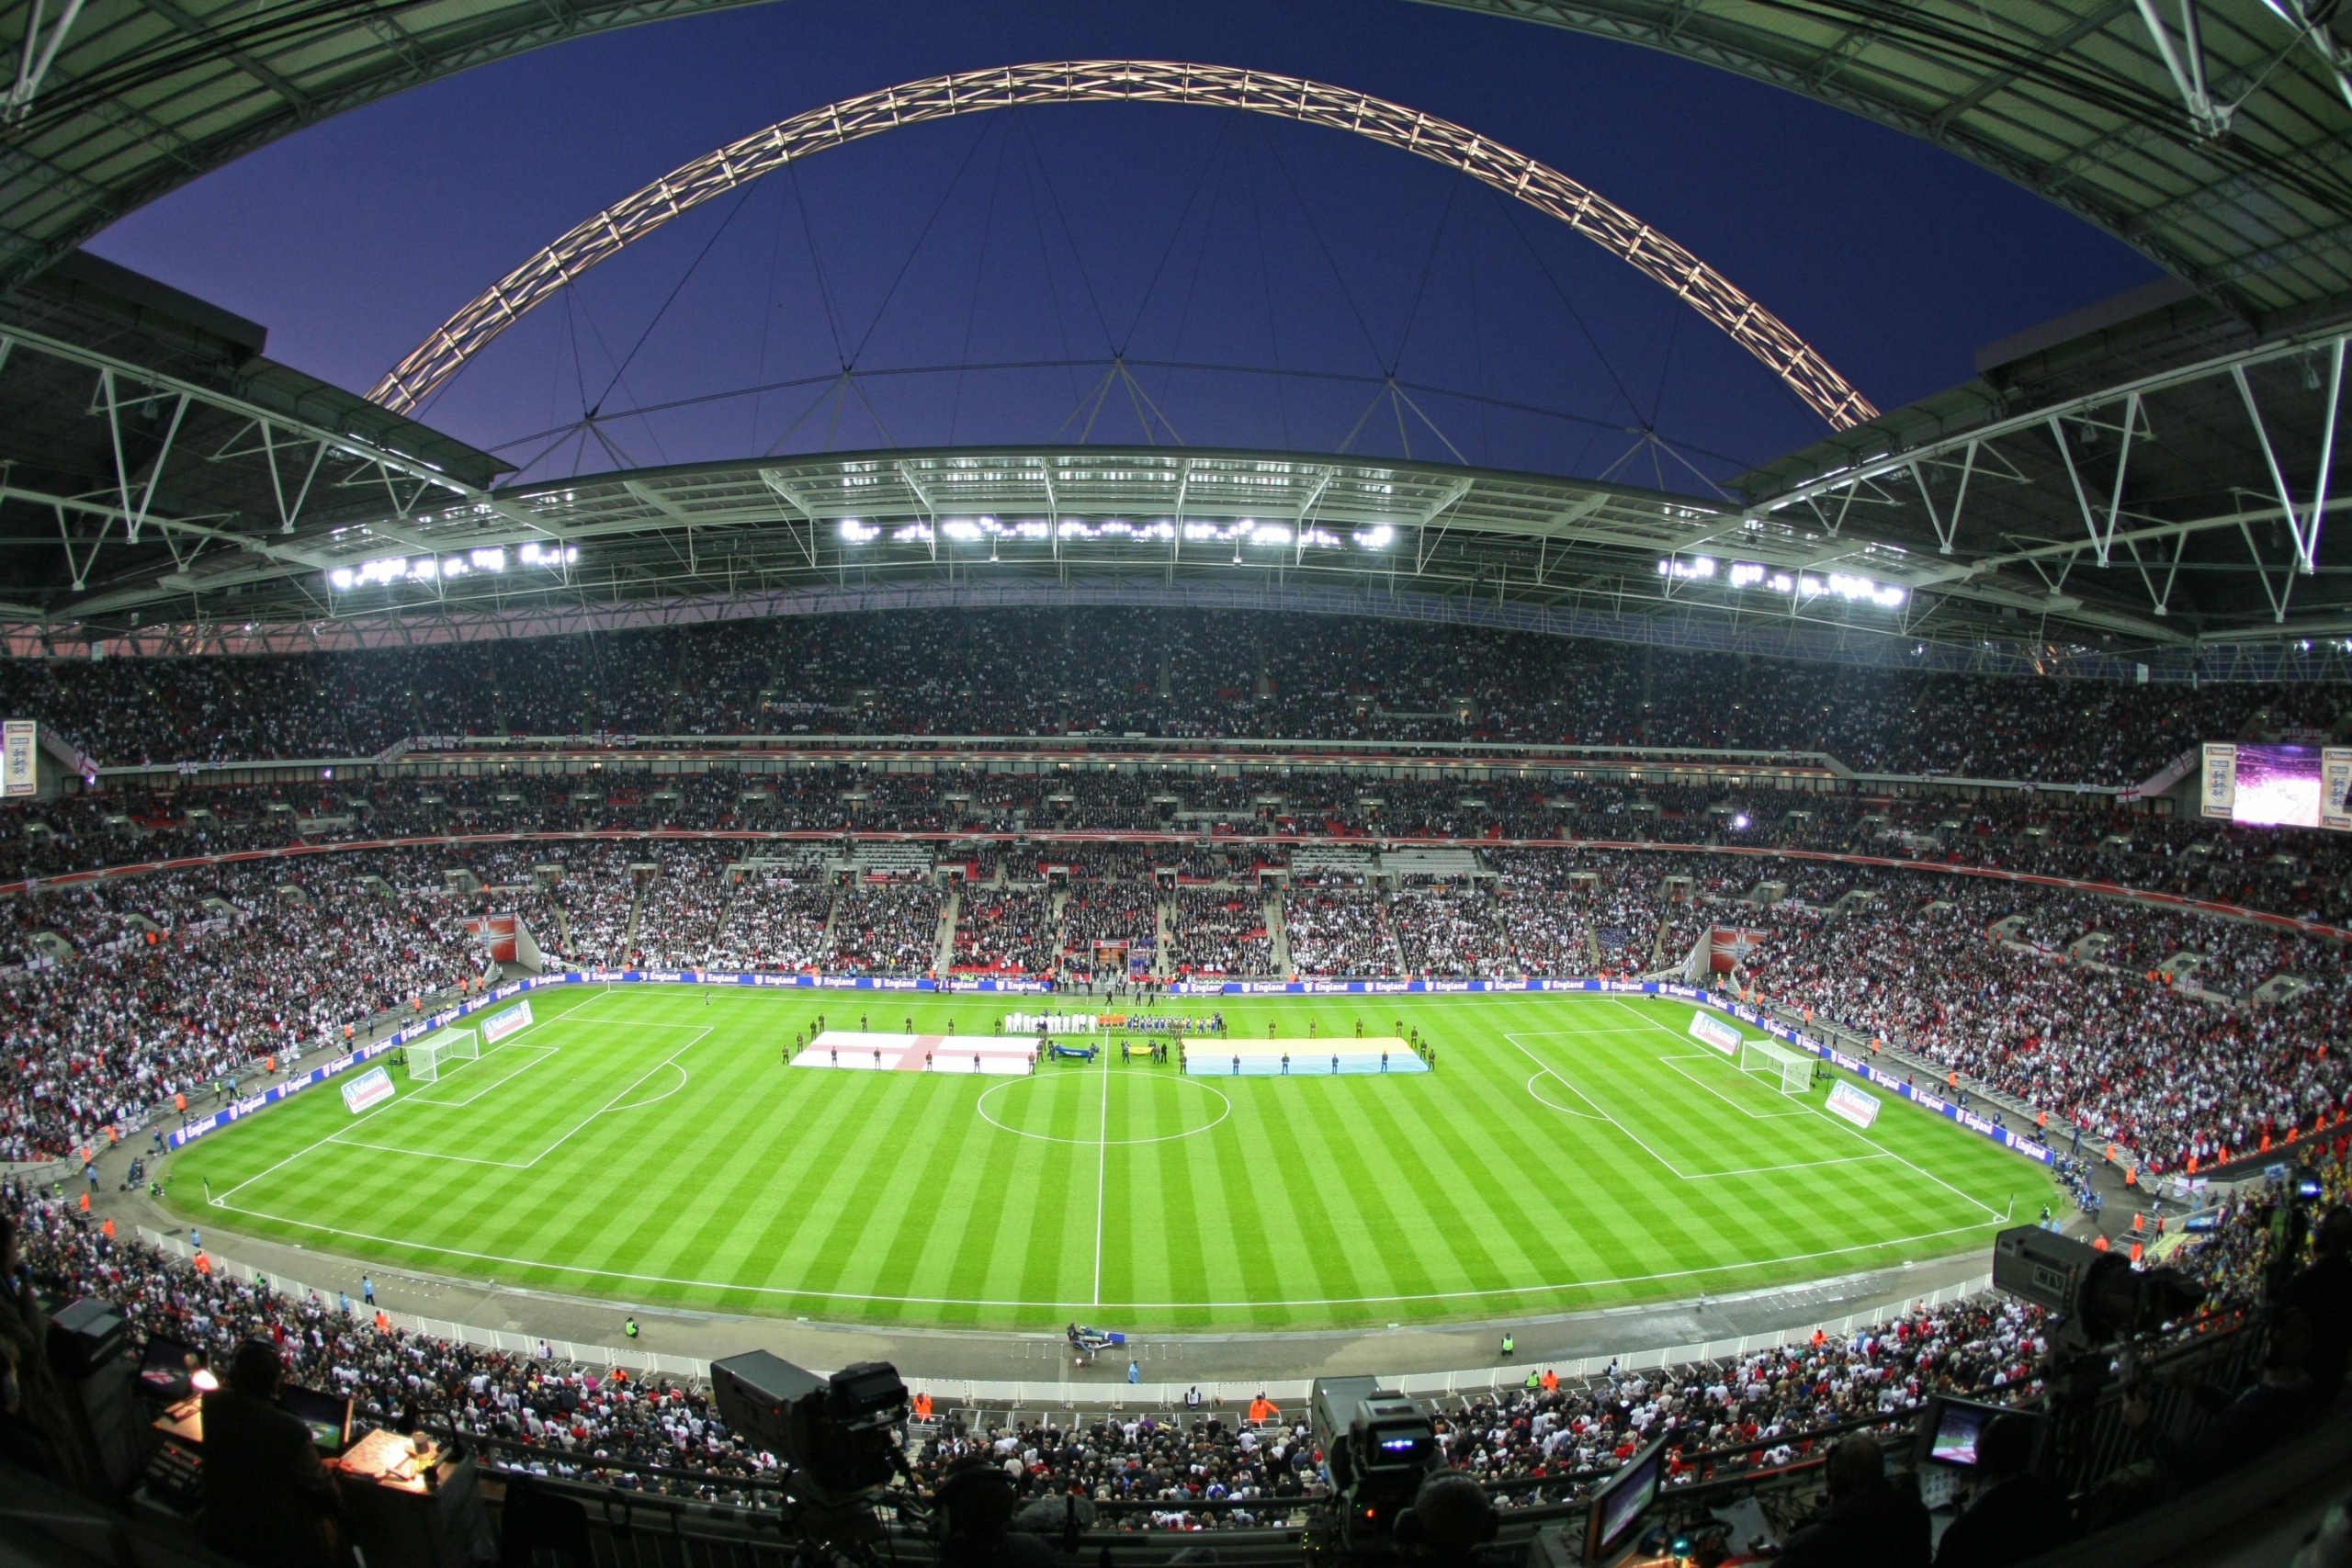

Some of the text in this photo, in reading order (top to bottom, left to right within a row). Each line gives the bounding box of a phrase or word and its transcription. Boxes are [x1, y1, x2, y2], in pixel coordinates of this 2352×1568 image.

[537, 974, 565, 984] England
[650, 972, 681, 982] England
[707, 974, 738, 983] England
[765, 976, 797, 985] England
[824, 977, 855, 987] England
[885, 979, 916, 988] England
[501, 982, 520, 996] England
[1008, 981, 1040, 991] England
[1253, 983, 1286, 993] England
[1315, 983, 1348, 992] England
[1375, 982, 1408, 992] England
[1436, 982, 1468, 991] England
[1495, 981, 1526, 991] England
[1553, 980, 1584, 990] England
[1611, 982, 1643, 991] England
[1669, 985, 1696, 996] England
[472, 996, 489, 1009] England
[1712, 996, 1727, 1010] England
[442, 1008, 459, 1022] England
[491, 1007, 522, 1032] Nationwide
[1739, 1008, 1757, 1022] England
[407, 1022, 427, 1038] England
[1708, 1021, 1737, 1046] Nationwide
[1769, 1021, 1788, 1037] England
[371, 1038, 391, 1054] England
[1802, 1036, 1820, 1053] England
[331, 1055, 354, 1073] England
[1838, 1054, 1859, 1071] England
[287, 1074, 311, 1092] England
[352, 1071, 387, 1098] Nationwide
[1876, 1071, 1900, 1090] England
[239, 1093, 266, 1114] England
[1841, 1086, 1874, 1115] Nationwide
[1918, 1091, 1944, 1111] England
[187, 1115, 216, 1138] England
[1964, 1111, 1993, 1134] England
[2016, 1136, 2045, 1160] England
[2036, 1269, 2063, 1288] CTV
